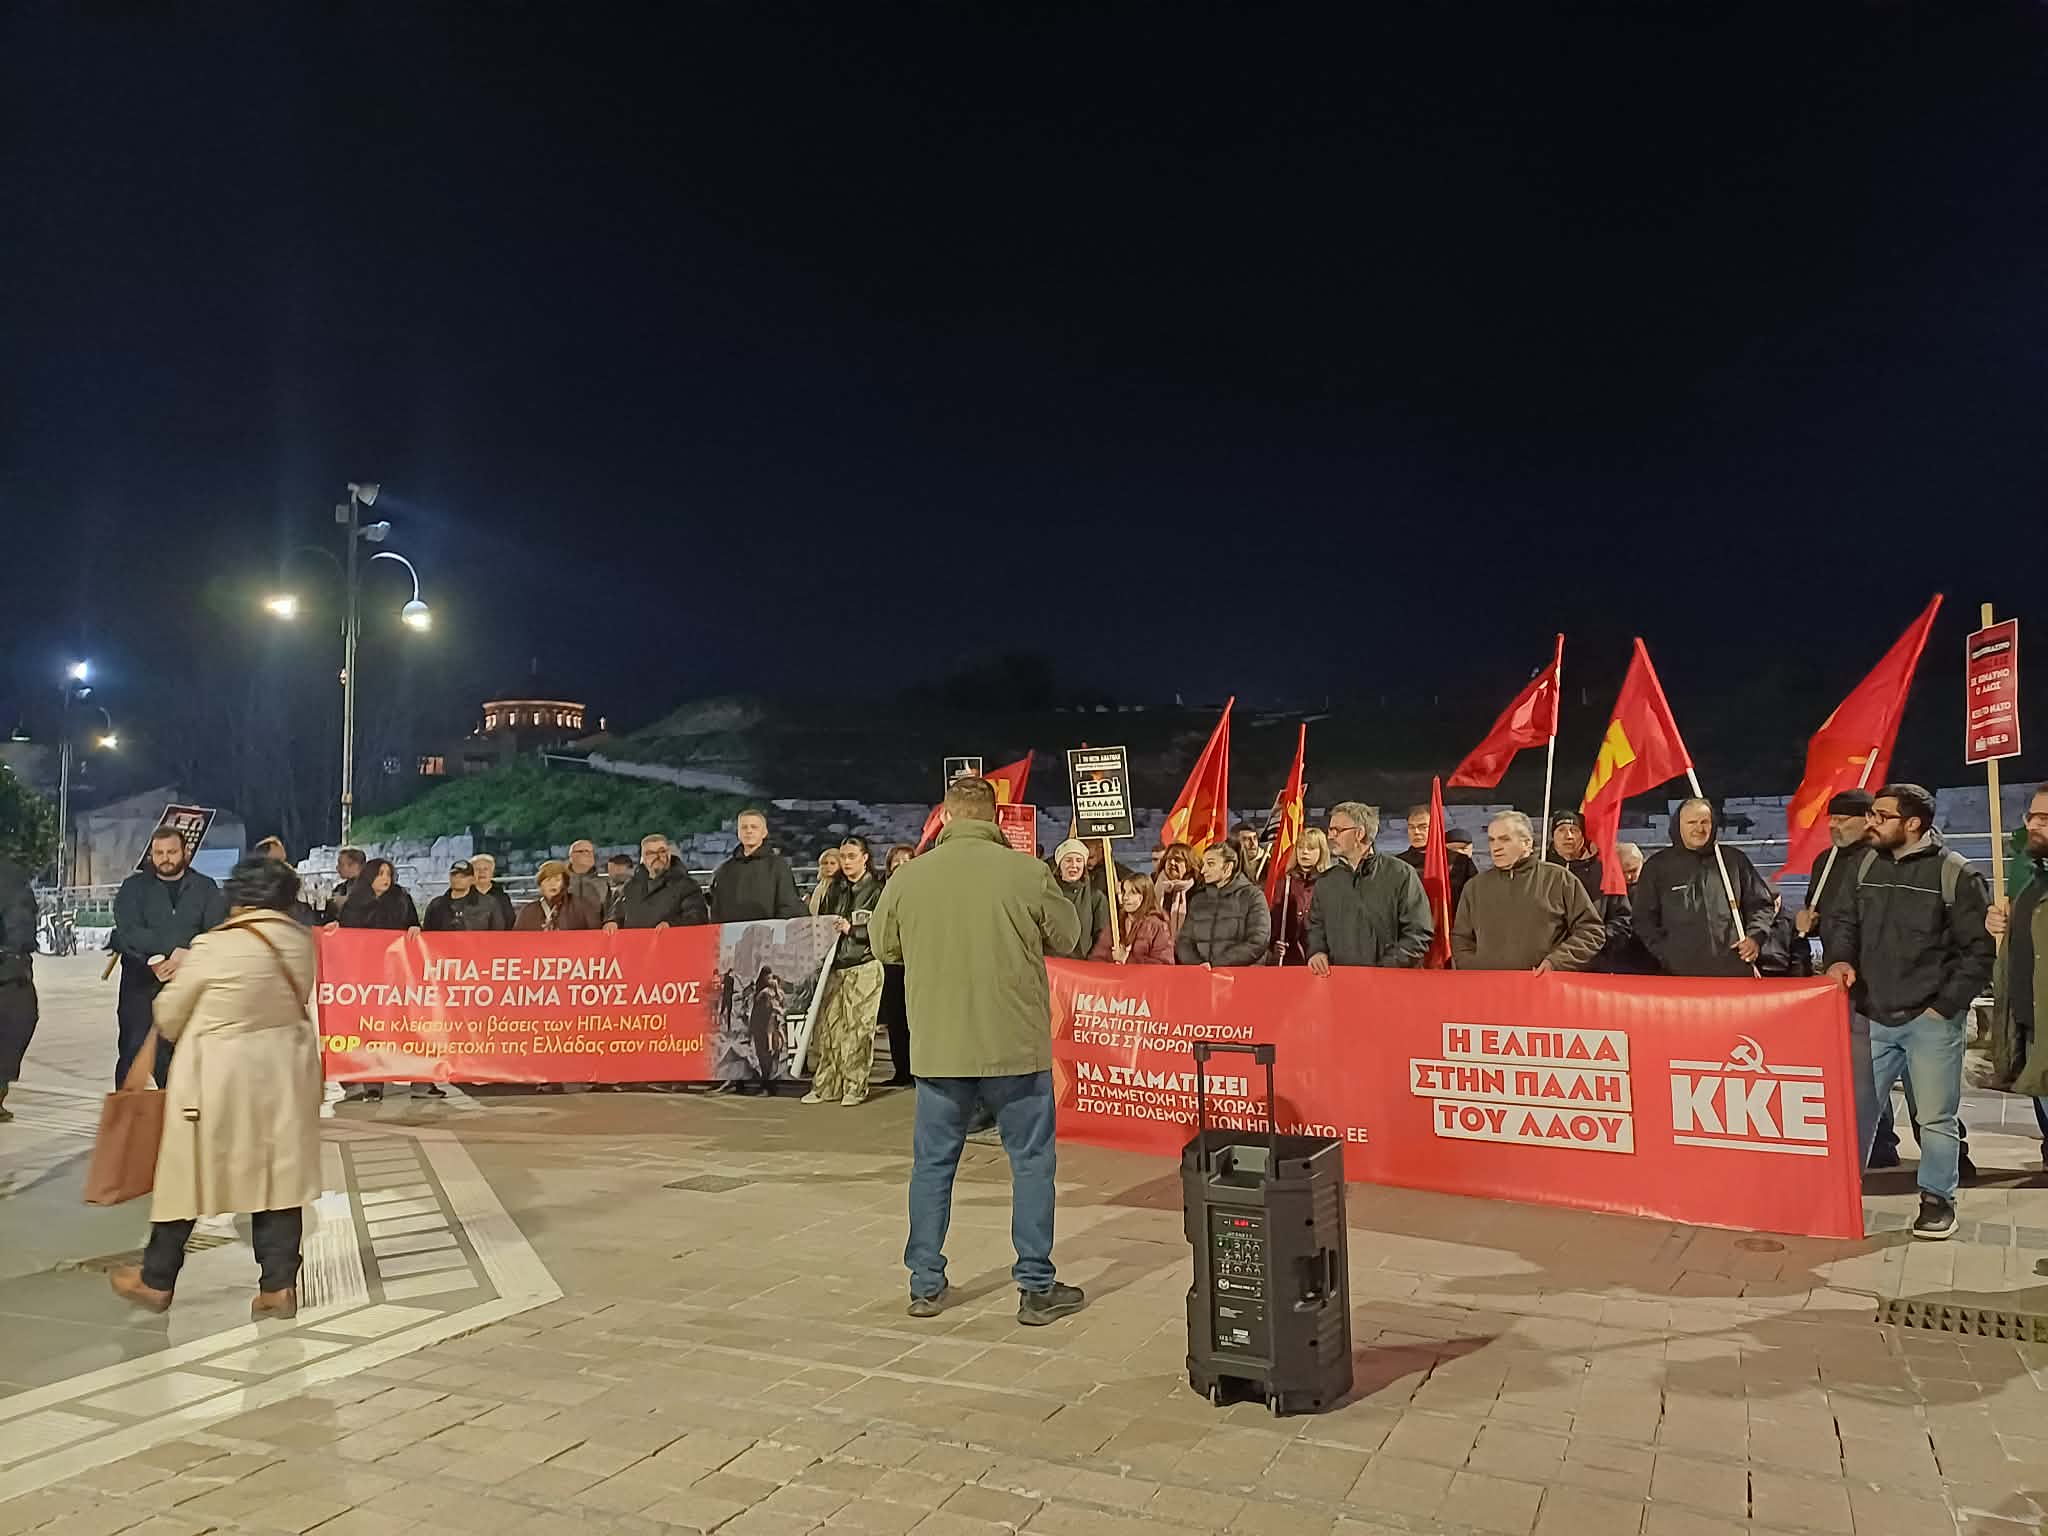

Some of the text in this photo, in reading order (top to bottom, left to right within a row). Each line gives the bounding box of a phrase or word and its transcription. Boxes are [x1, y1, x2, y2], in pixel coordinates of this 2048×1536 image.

[1079, 778, 1119, 795] ΕΞΩ!
[422, 957, 623, 981] ΗΠΑ-ΕΕ-ΙΣΡΑΗΛ
[319, 981, 700, 1007] ΒΟΥΤΑΝΕ ΣΤΟ ΑΙΜΑ ΤΟΥΣ ΛΑΟΥΣ
[1076, 993, 1151, 1017] ΚΑΜΙΑ
[360, 1013, 667, 1034] Να κλείσουν οι βάσεις των ΗΠΑ-ΝΑΤΟ!
[1073, 1014, 1253, 1039] ΣΤΡΑΤΙΩΤΙΚΗ ΑΠΟΣΤΟΛΗ
[319, 1032, 704, 1057] TOP στη συμμετοχή της Ελλάδας στον πόλεμο!
[1073, 1030, 1120, 1047] ΕΚΤΟΣ
[1449, 1029, 1620, 1062] Η ΕΛΠΙΔΑ
[1076, 1061, 1105, 1082] ΝΑ
[1415, 1064, 1621, 1103] ΣΤΗΝ ΠΑΛΗ
[1078, 1082, 1087, 1095] Η
[1090, 1084, 1176, 1107] ΣΥΜΜΕΤΟΧΗ
[1213, 1098, 1268, 1116] ΧΩΡΑΣ
[1670, 1074, 1828, 1142] ΚΚΕ
[1077, 1098, 1122, 1115] ΣΤΟΥΣ
[1125, 1104, 1200, 1126] ΠΟΛΕΜΟΥ
[1209, 1115, 1246, 1130] ΤΩΝ
[1290, 1123, 1337, 1137] ΝΑΤΟ
[1347, 1127, 1368, 1143] ΕΕ
[1439, 1104, 1621, 1144] ΤΟΥ ΛΑΟΥ
